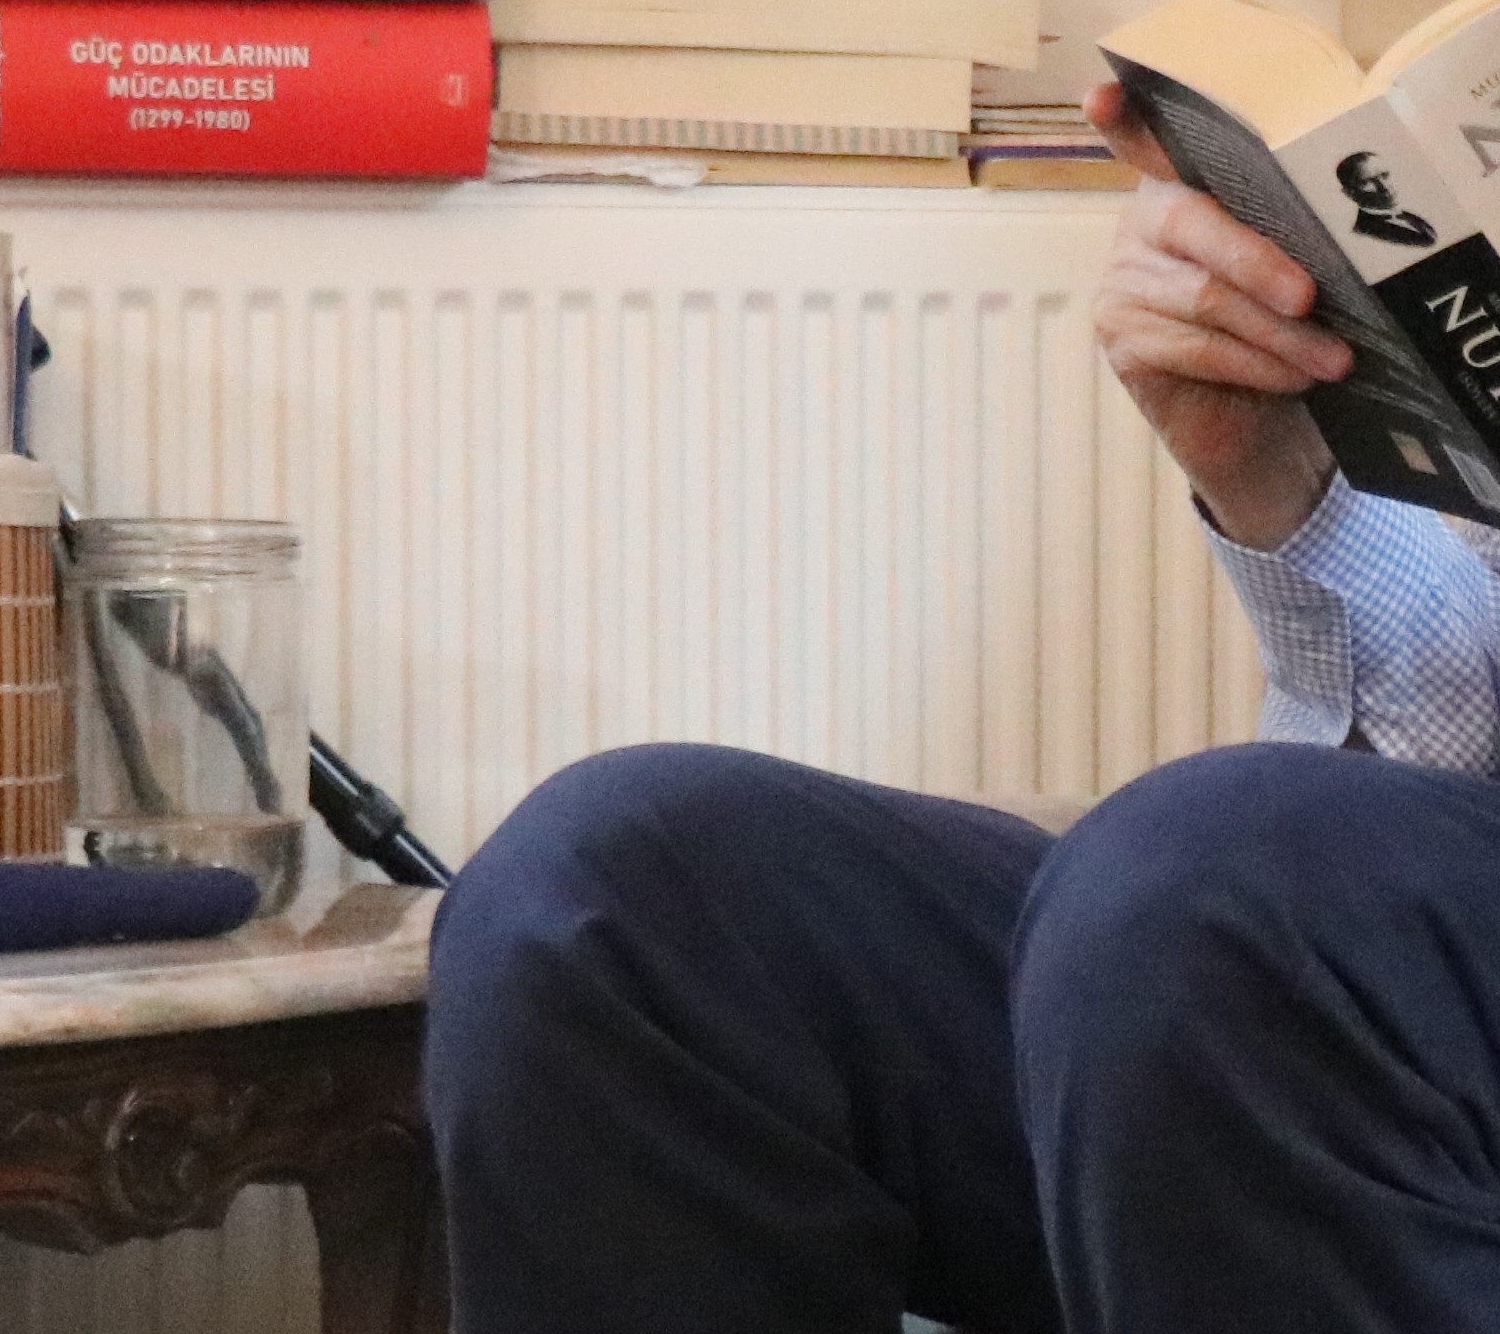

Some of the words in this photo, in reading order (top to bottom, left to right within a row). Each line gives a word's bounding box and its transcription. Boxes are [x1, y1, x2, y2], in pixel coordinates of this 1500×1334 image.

[70, 37, 123, 69] GÜÇ
[132, 42, 309, 69] ODAKLARININ
[107, 70, 275, 102] MÜCADELESİ
[129, 108, 250, 132] (1299-1980)
